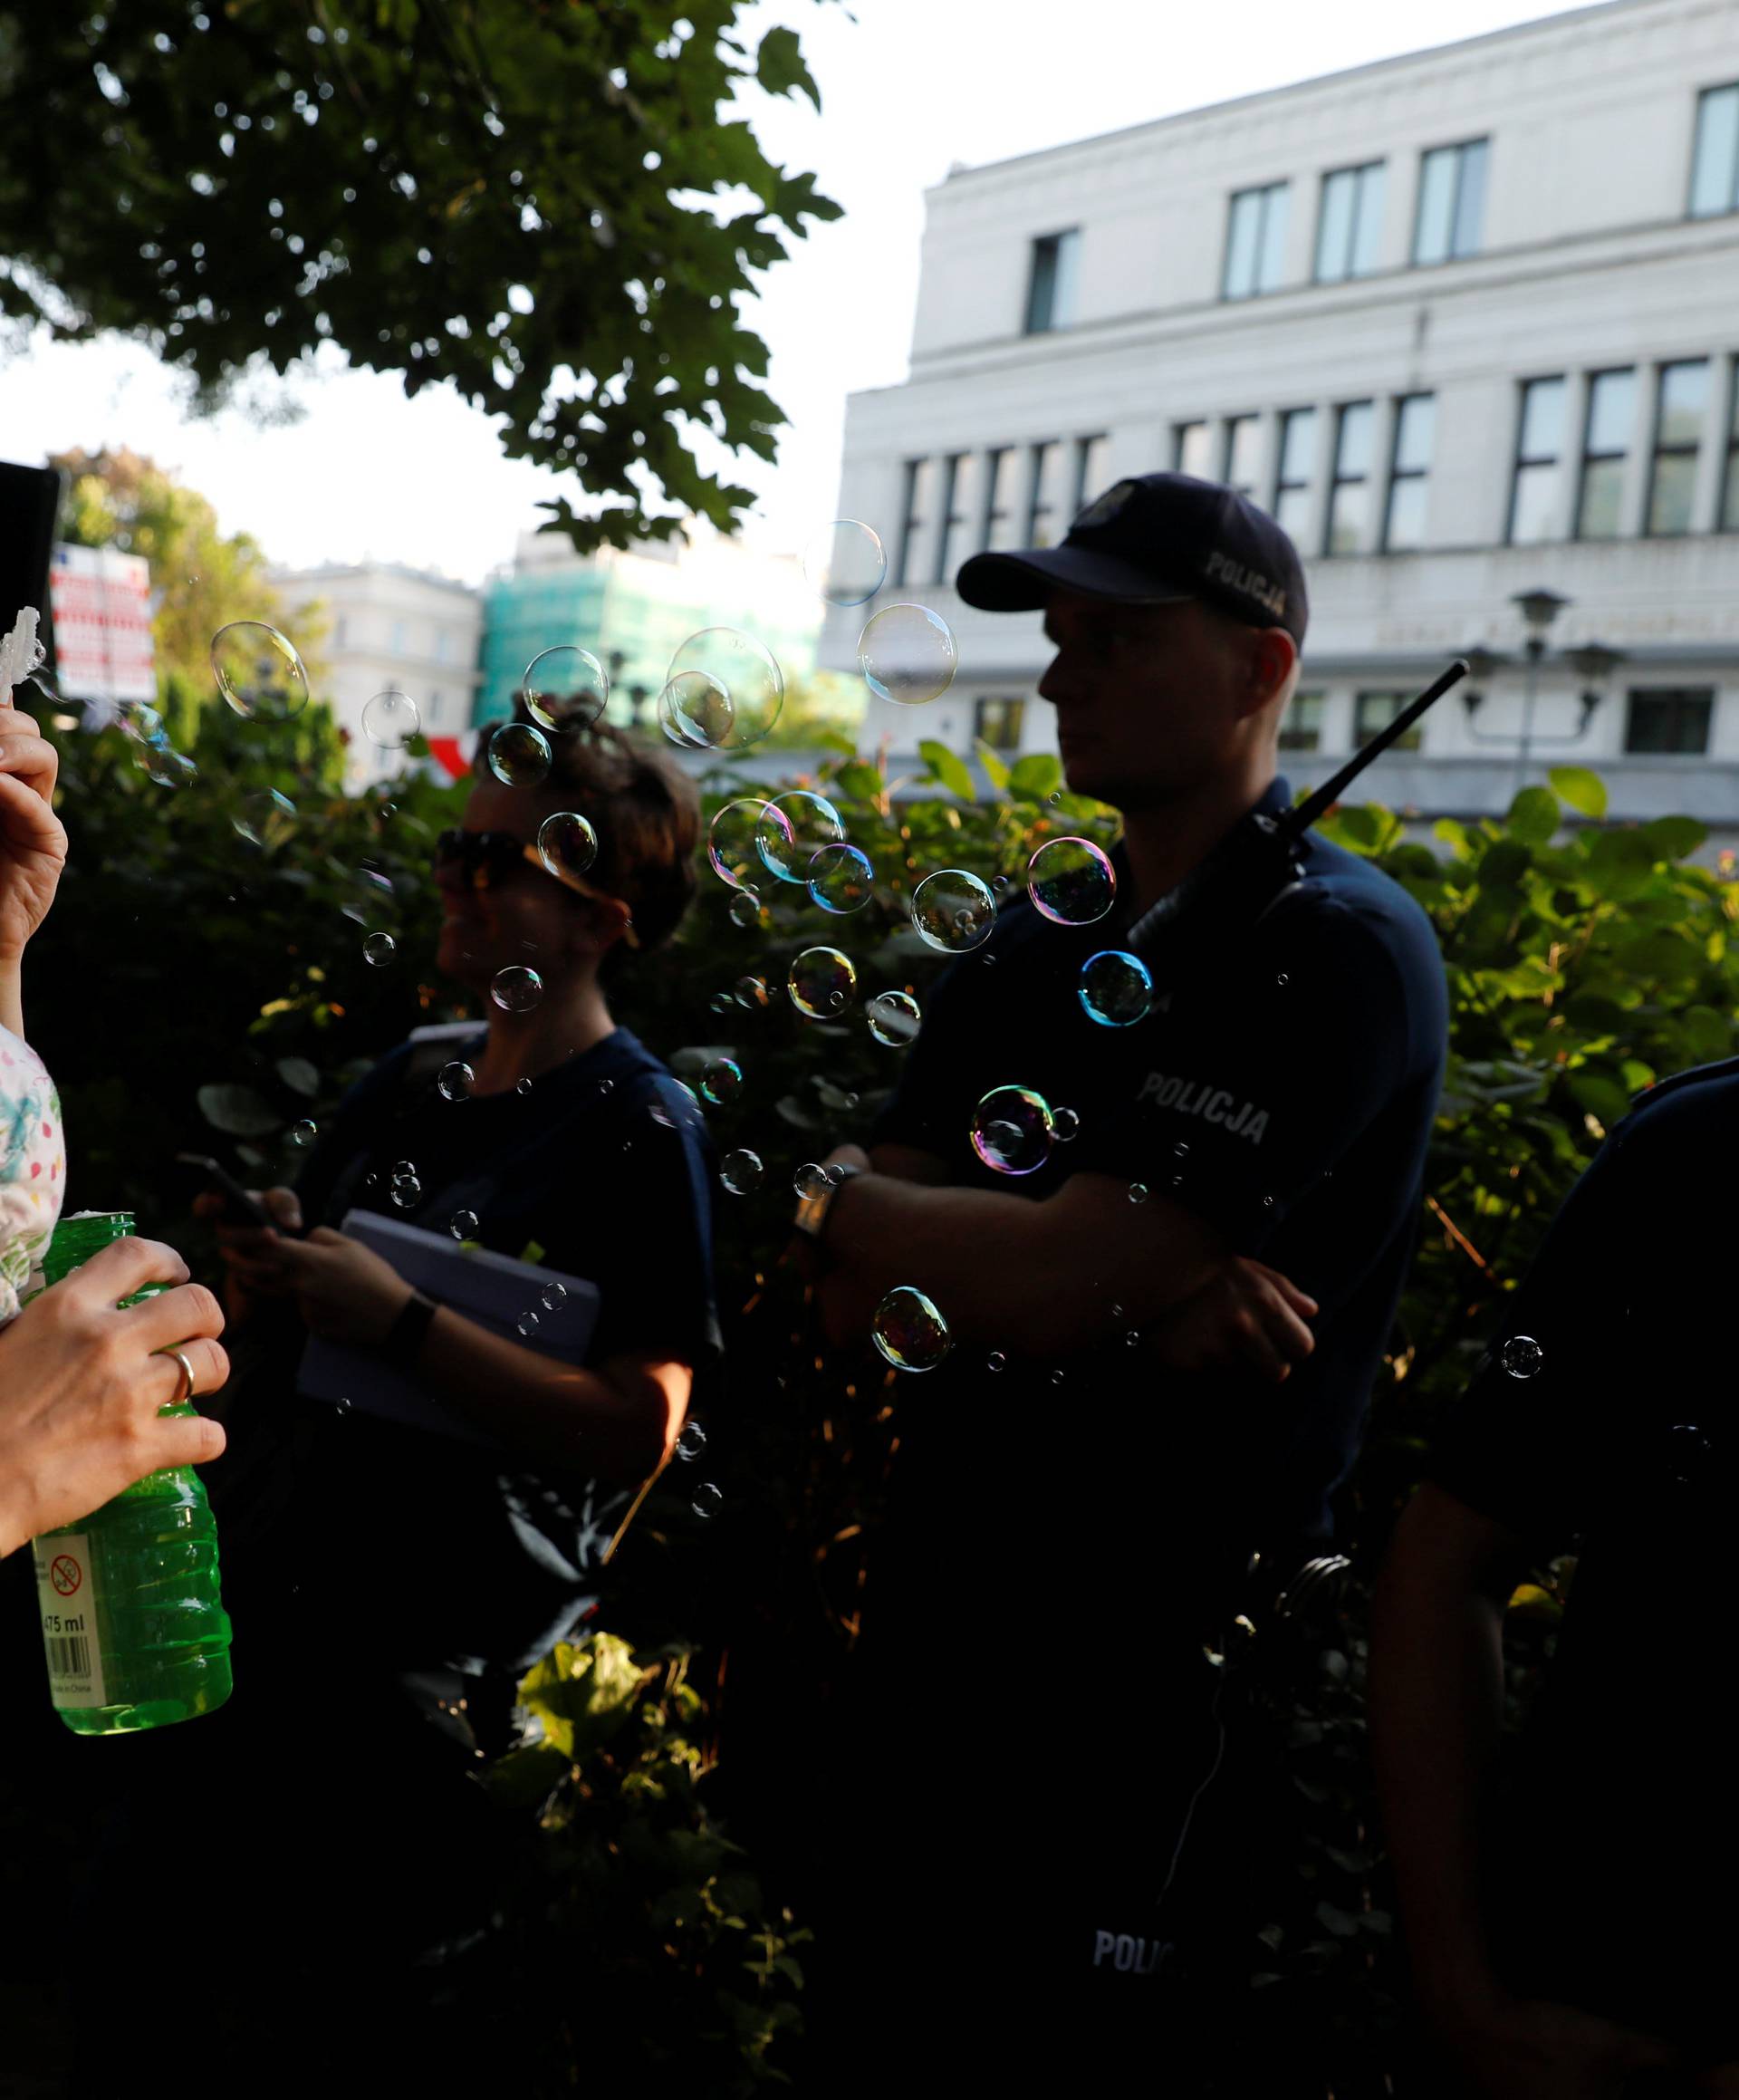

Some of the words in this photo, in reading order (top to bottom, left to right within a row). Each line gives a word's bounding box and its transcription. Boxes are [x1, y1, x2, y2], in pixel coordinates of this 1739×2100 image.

[1205, 551, 1286, 616] POLICJA
[1136, 1069, 1271, 1145] POLICJA
[64, 1614, 84, 1632] ml
